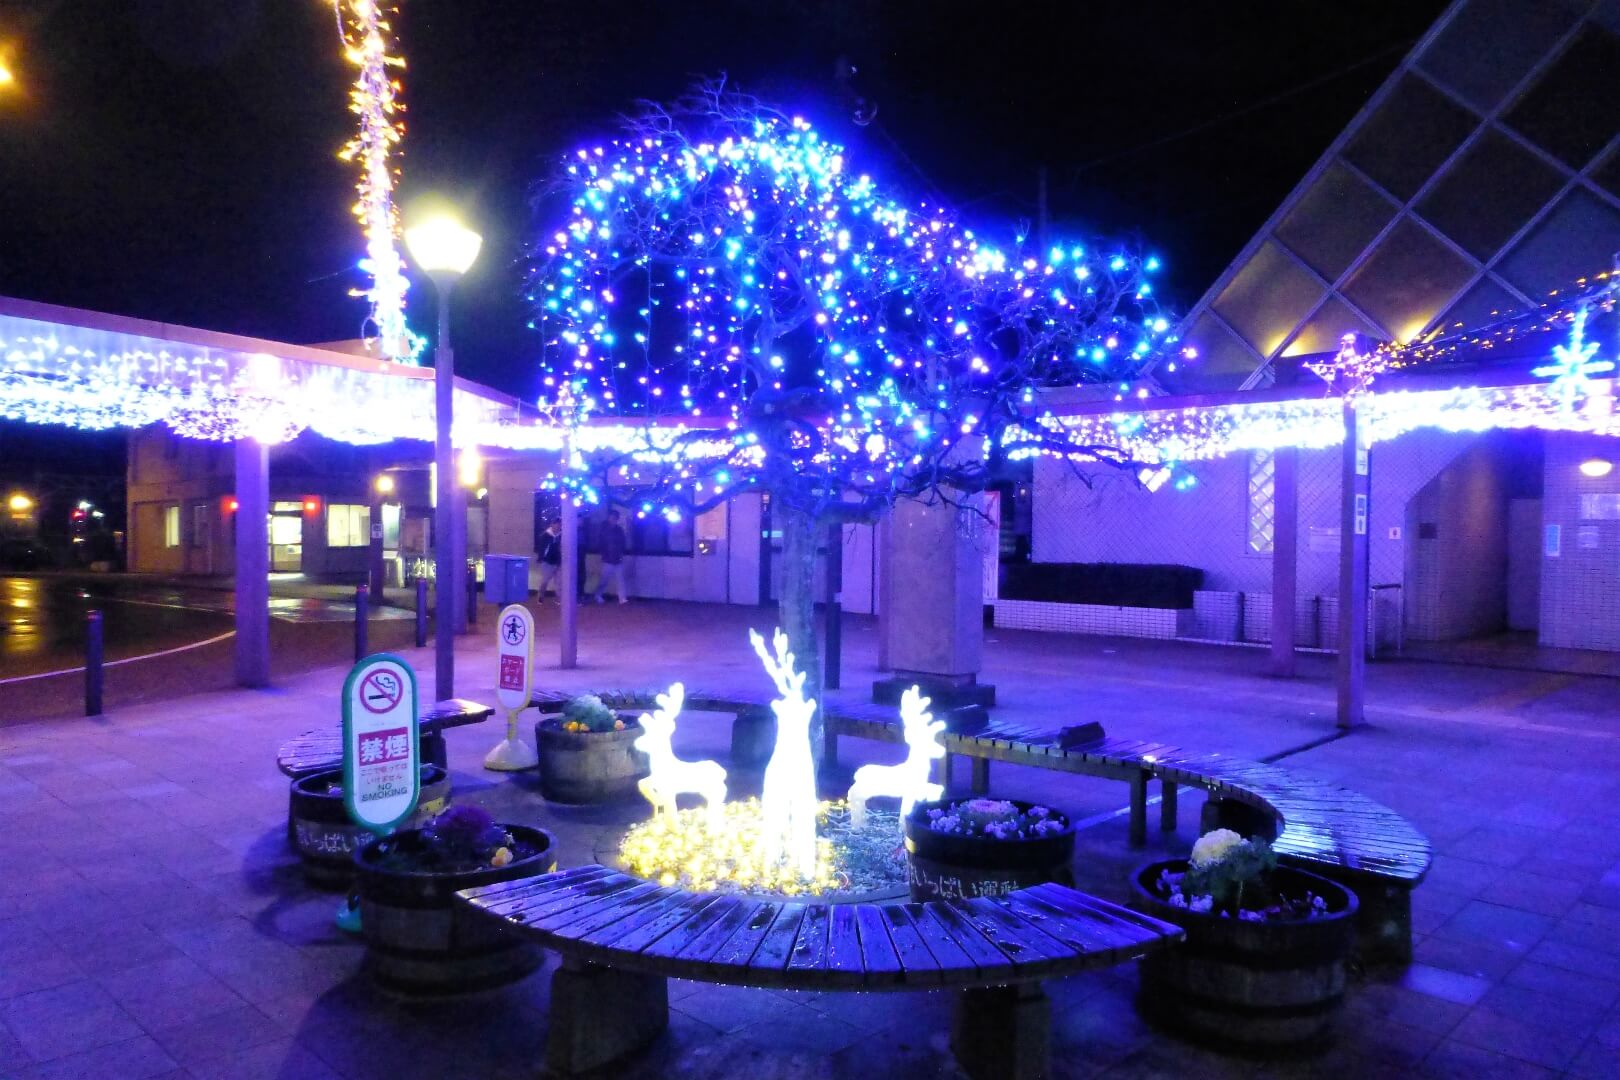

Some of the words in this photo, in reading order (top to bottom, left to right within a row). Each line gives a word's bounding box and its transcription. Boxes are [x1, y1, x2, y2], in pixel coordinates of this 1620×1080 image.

[360, 733, 408, 763] 禁煙
[361, 787, 408, 802] SMOKING
[378, 783, 393, 791] NO
